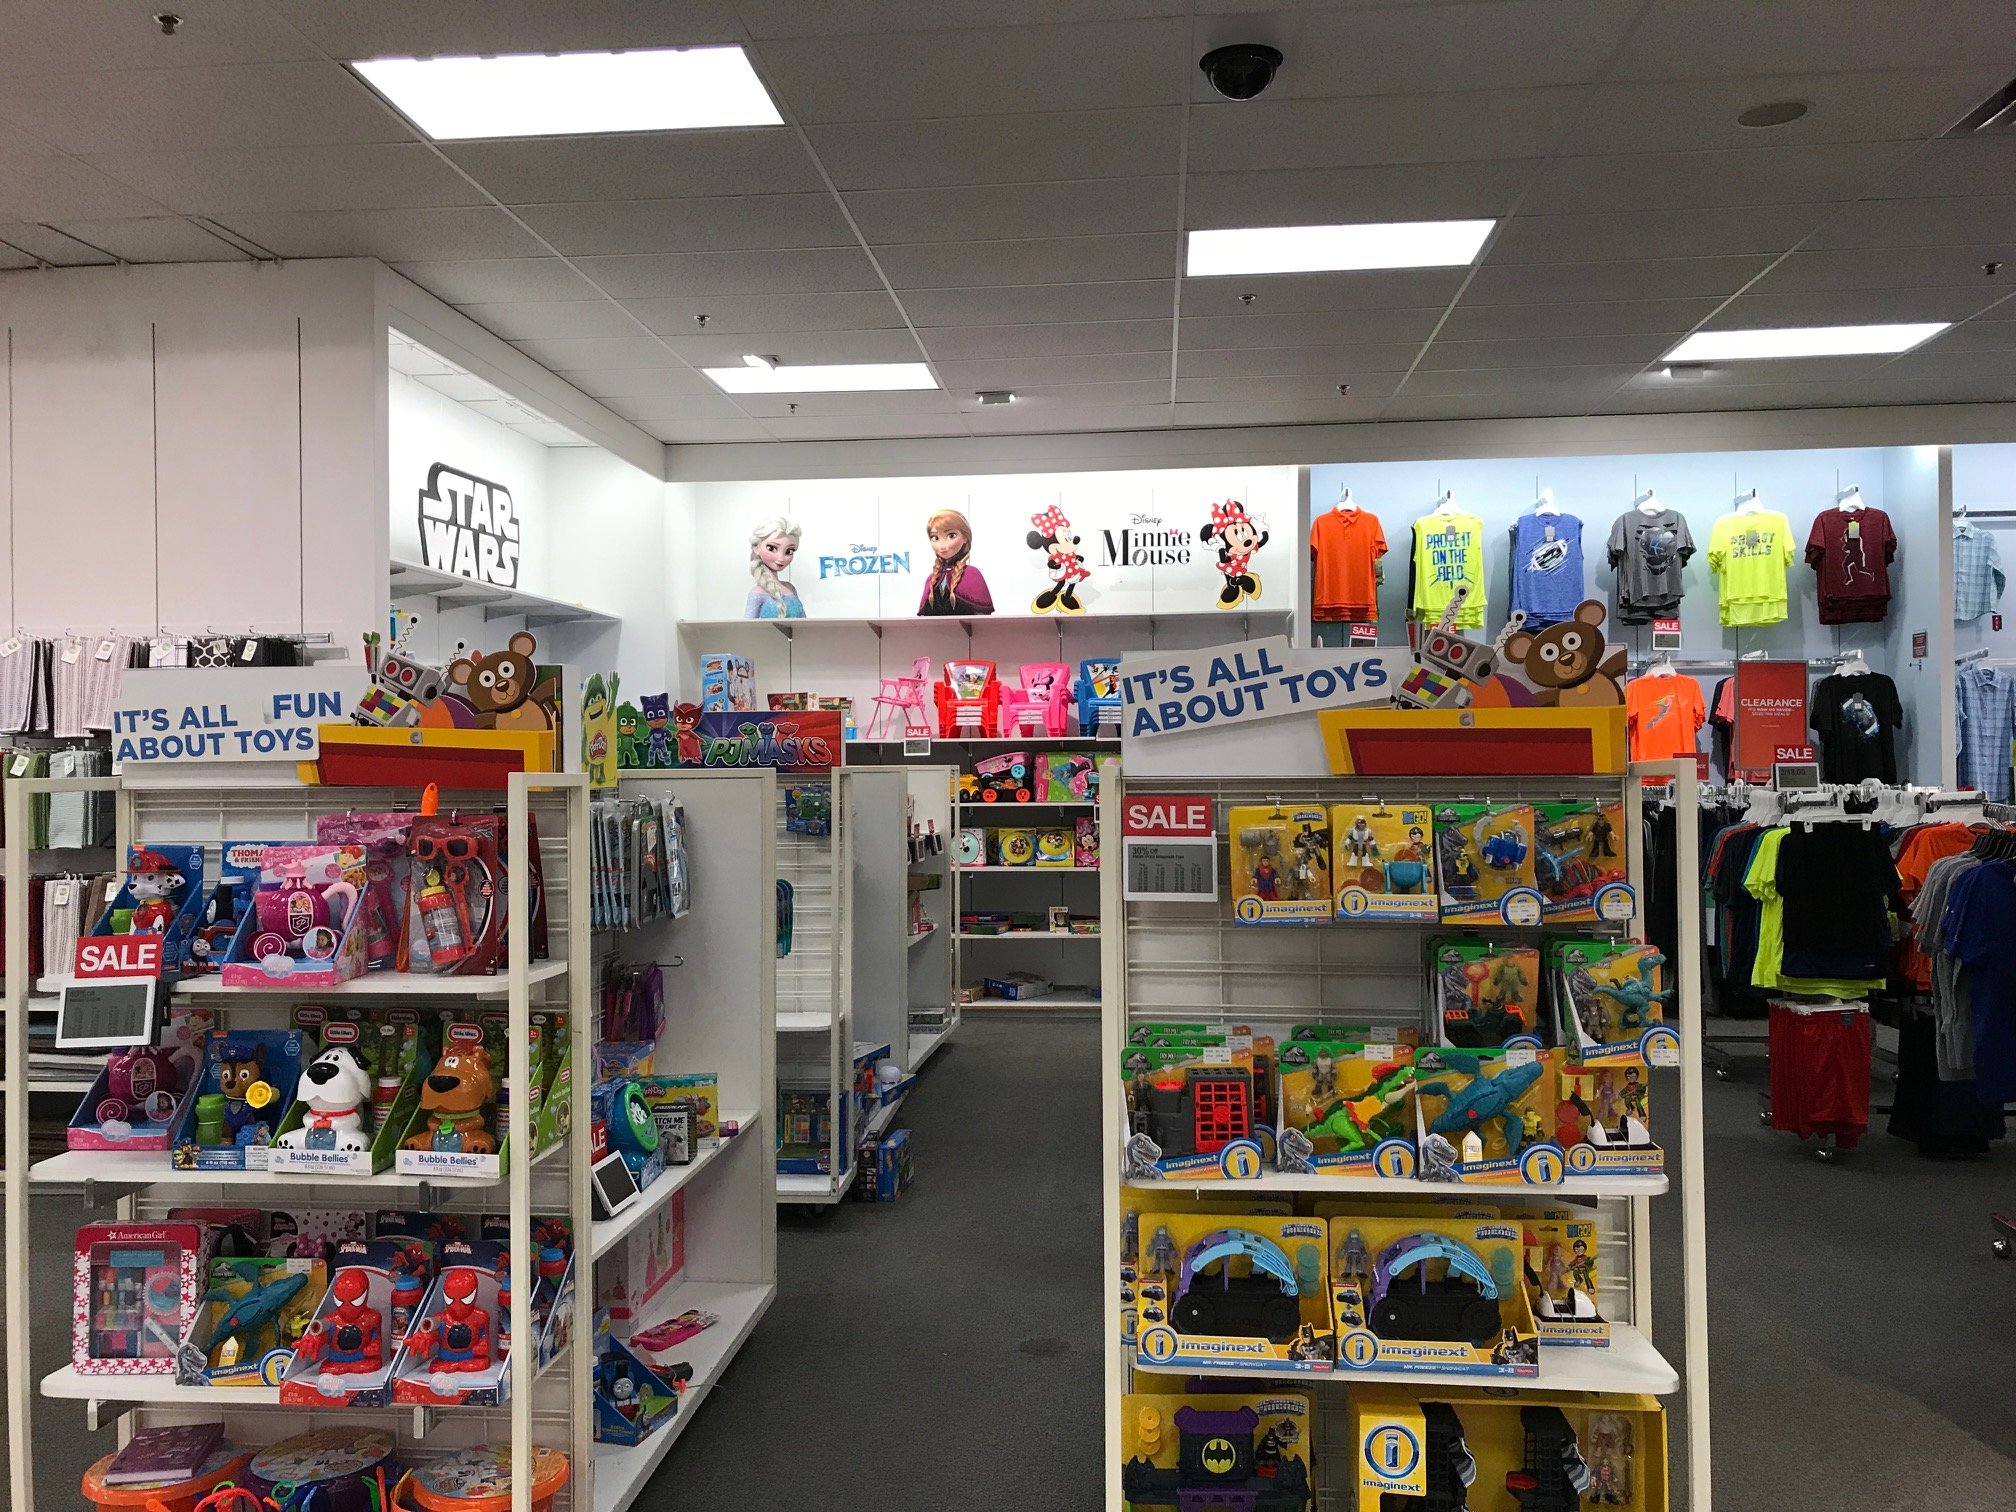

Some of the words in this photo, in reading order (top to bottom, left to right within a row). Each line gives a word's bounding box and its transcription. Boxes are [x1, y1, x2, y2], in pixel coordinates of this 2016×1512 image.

[420, 464, 518, 541] STAR
[1129, 513, 1162, 526] Disney
[849, 544, 878, 554] Disney
[1098, 528, 1190, 560] Minnie
[419, 517, 518, 588] WARS
[1432, 550, 1447, 565] ON
[1449, 549, 1467, 564] THE
[1733, 545, 1771, 558] SKILLS
[818, 551, 911, 579] FROZEN
[1437, 566, 1464, 581] FIELD
[1352, 627, 1376, 636] SALE
[1655, 622, 1679, 630] SALE
[1123, 665, 1195, 704] IT'S
[1208, 648, 1283, 687] ALL
[1133, 681, 1268, 737] ABOUT
[1280, 658, 1388, 704] TOYS
[1740, 698, 1803, 707] CLEARANCE
[113, 708, 170, 733] IT'S
[179, 704, 238, 730] ALL
[272, 691, 342, 720] FUN
[906, 728, 929, 736] SALE
[116, 732, 225, 761] ABOUT
[233, 727, 314, 754] TOYS
[1777, 748, 1812, 759] SALE
[1128, 805, 1206, 830] SALE
[1266, 904, 1328, 914] imaginext
[1370, 898, 1435, 908] imaginext
[1444, 901, 1499, 914] imaginext
[1543, 898, 1593, 912] maginext
[80, 944, 157, 972] SALE
[1585, 1042, 1639, 1057] imaginext
[591, 1127, 606, 1153] LE
[290, 1152, 319, 1162] Bubble
[322, 1153, 348, 1163] Bellies
[418, 1155, 448, 1164] Bubble
[450, 1156, 476, 1166] Bellies
[1166, 1155, 1218, 1168] imaginext
[1317, 1152, 1371, 1164] imaginext
[1598, 1153, 1661, 1162] imaginext
[1463, 1159, 1519, 1171] imaginext
[117, 1231, 151, 1239] American
[152, 1230, 165, 1239] Girl
[1543, 1326, 1604, 1335] imaginext
[1181, 1340, 1265, 1353] imaginext
[1381, 1345, 1468, 1358] imaginext
[212, 1363, 259, 1376] imaginext
[1362, 1478, 1421, 1492] imaginext
